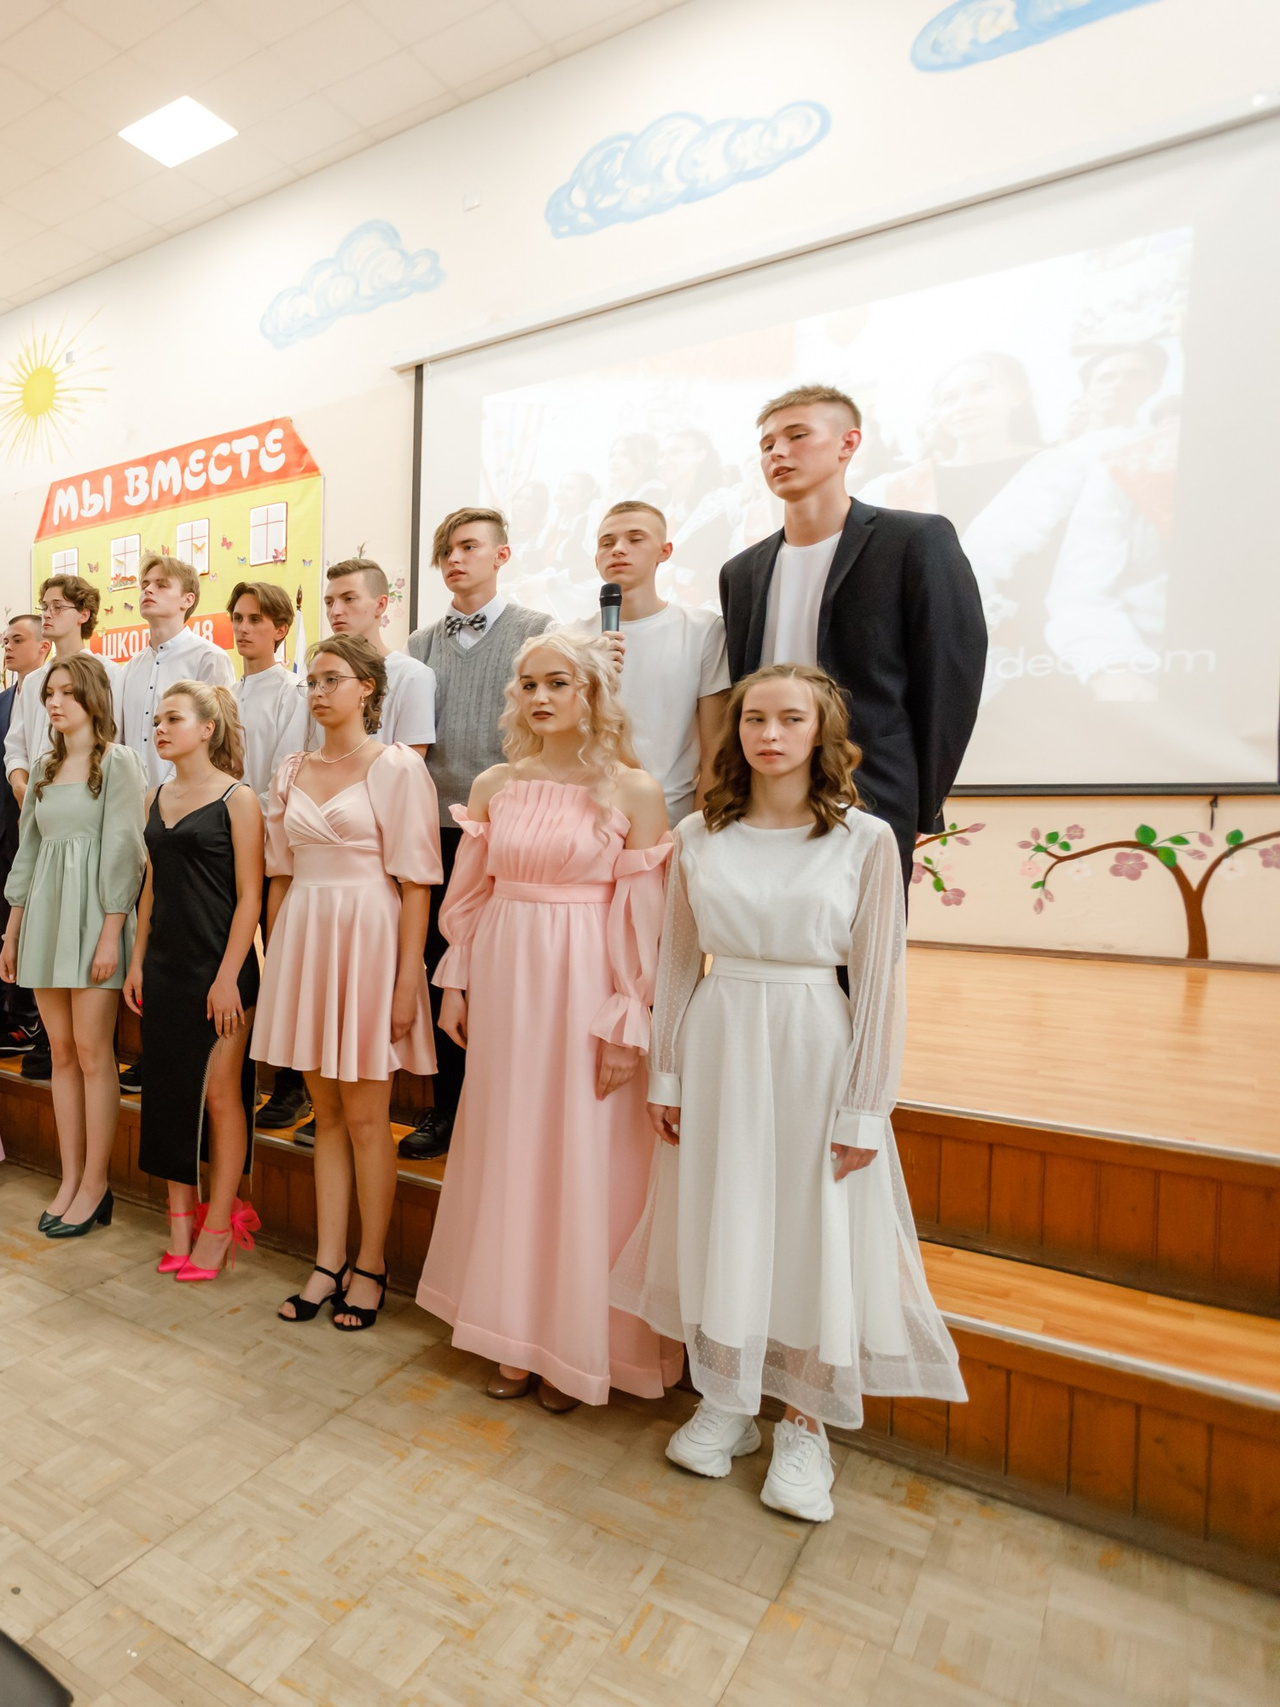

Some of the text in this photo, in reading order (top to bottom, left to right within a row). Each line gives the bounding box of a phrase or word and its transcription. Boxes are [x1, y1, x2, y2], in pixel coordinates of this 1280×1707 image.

[52, 427, 287, 526] МЫ ВМЕСТЕ
[102, 628, 151, 660] ШКОЛ
[986, 646, 1217, 679] ideo.com
